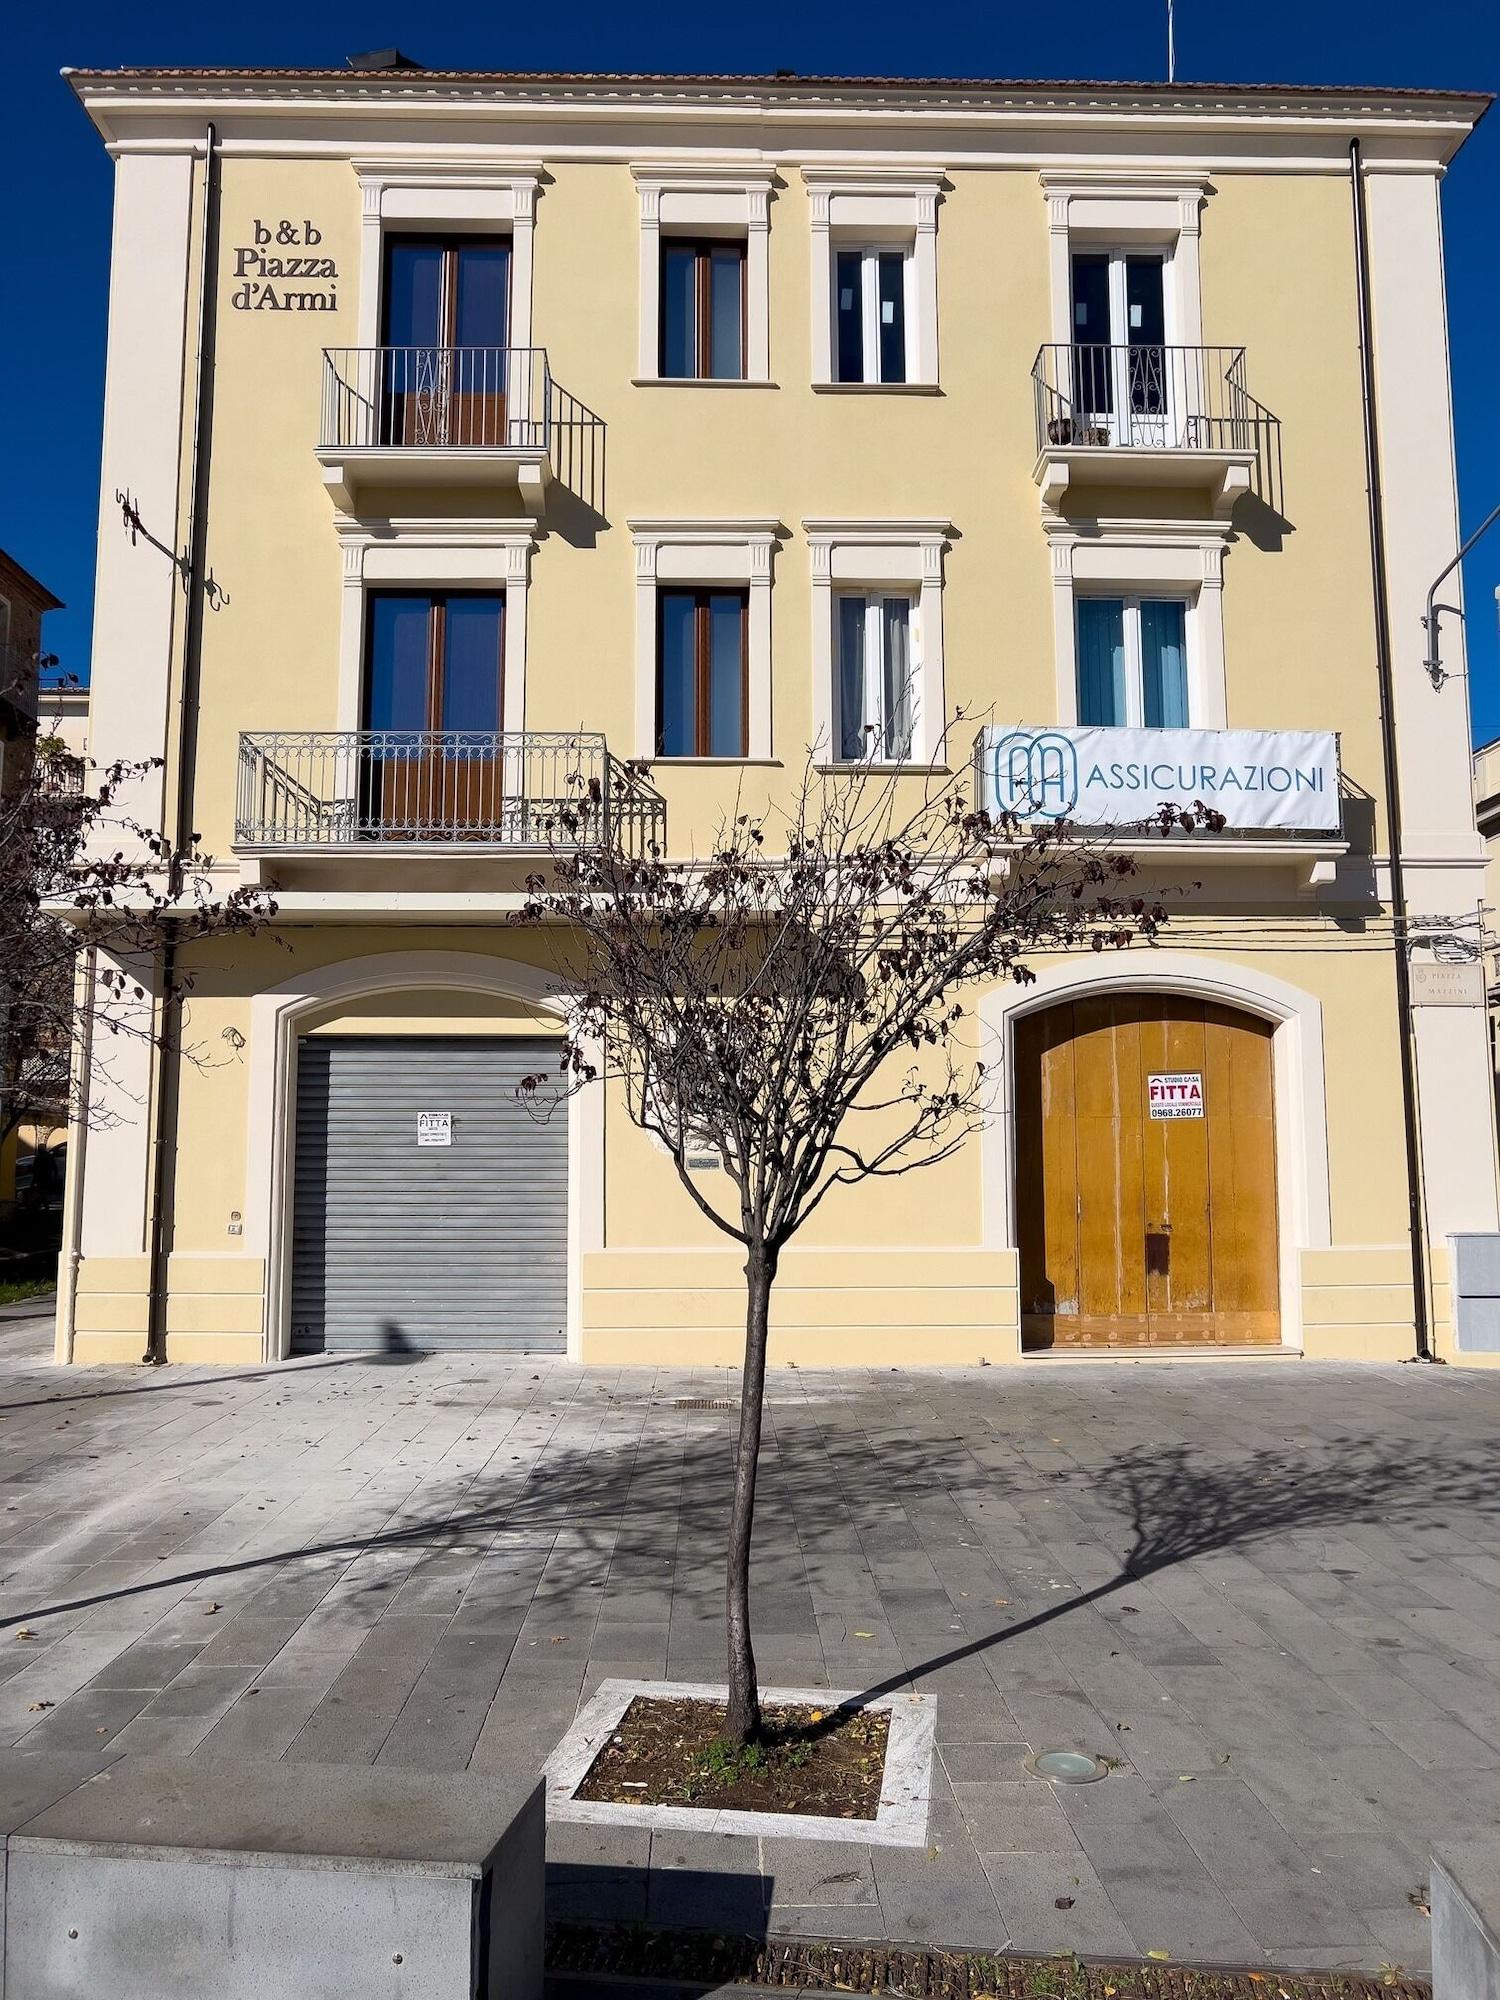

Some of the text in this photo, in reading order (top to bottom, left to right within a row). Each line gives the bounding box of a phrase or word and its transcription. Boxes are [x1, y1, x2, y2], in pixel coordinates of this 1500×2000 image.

[232, 247, 339, 278] Piazza
[231, 282, 338, 312] d'Armi
[1085, 762, 1324, 793] ASSICURAZIONI
[1150, 1085, 1200, 1100] FITTA
